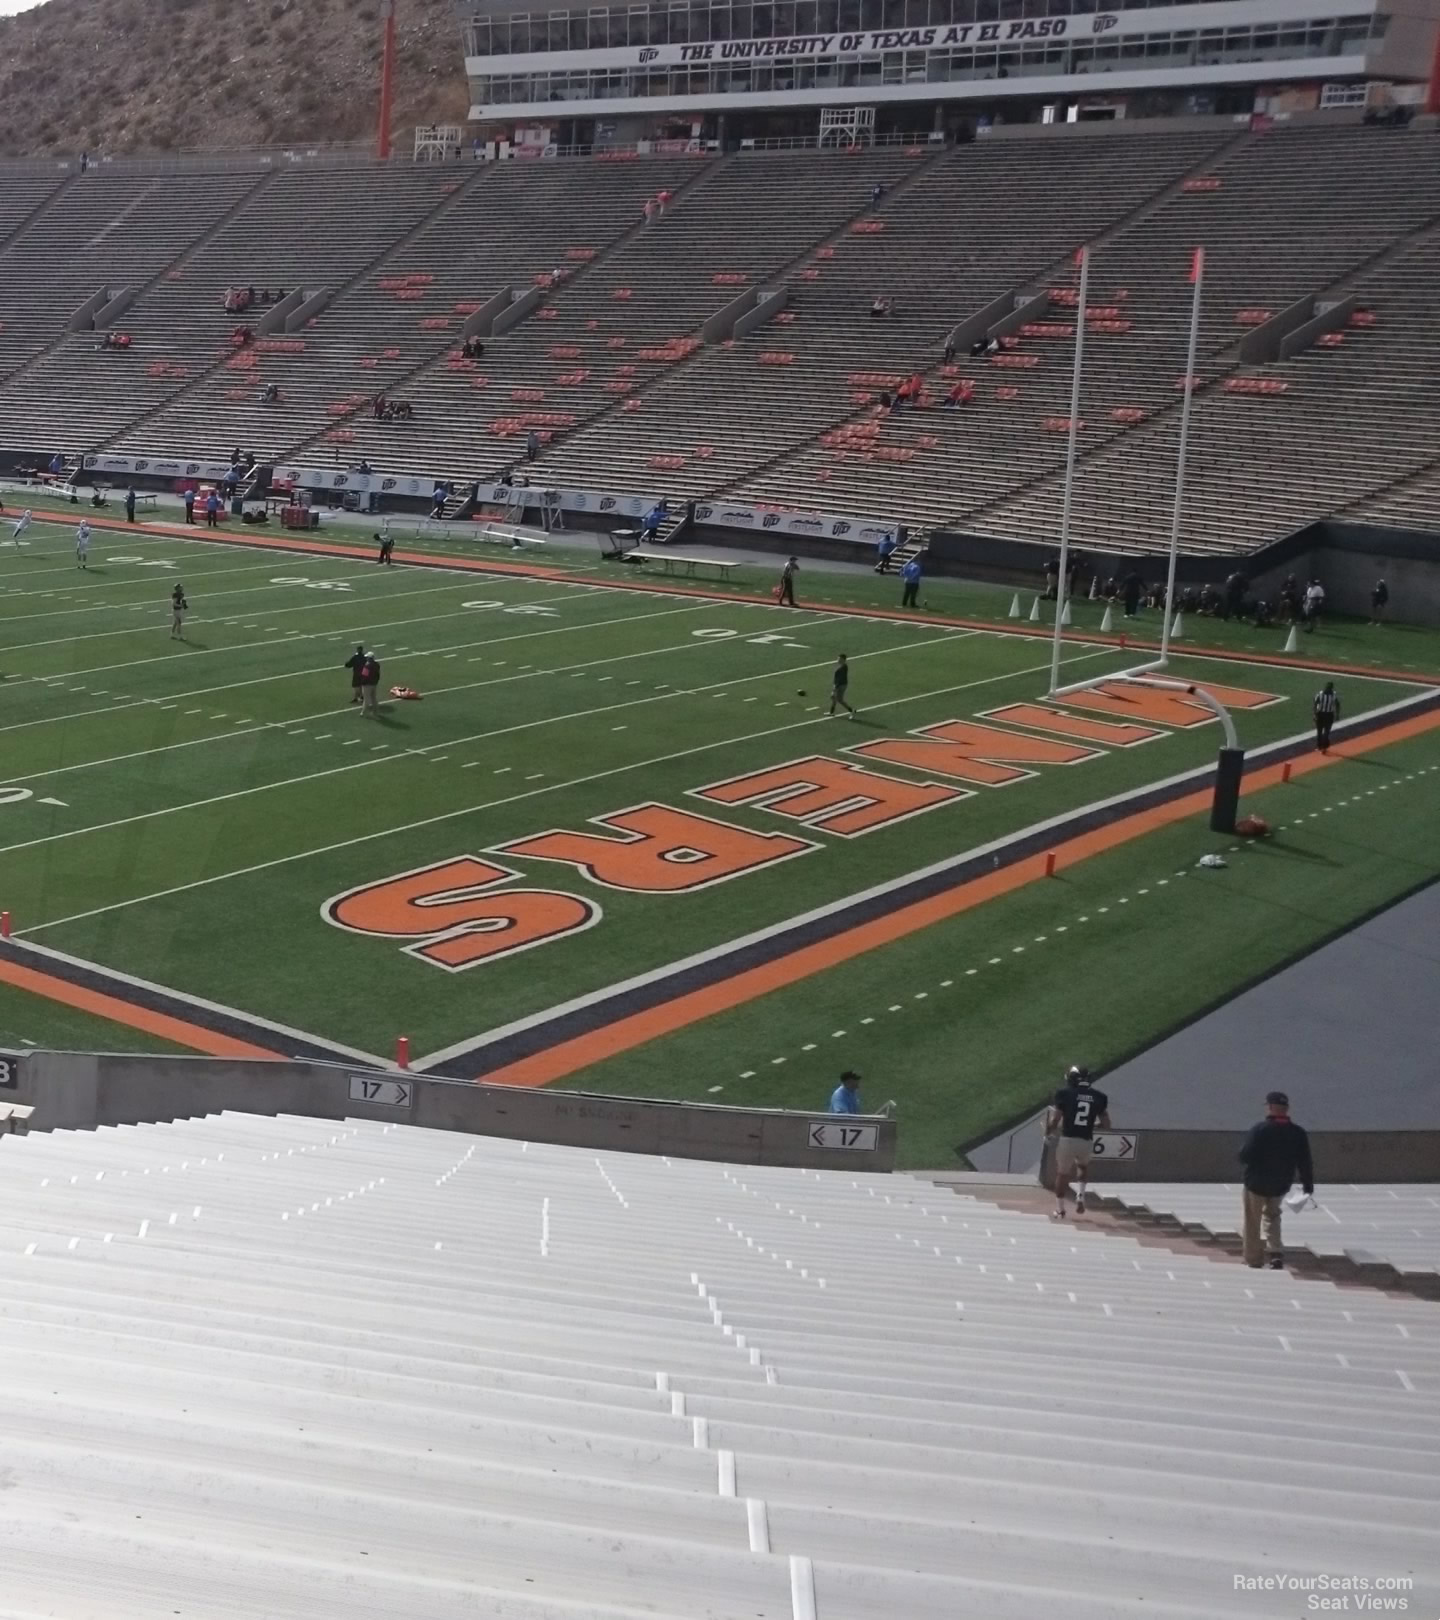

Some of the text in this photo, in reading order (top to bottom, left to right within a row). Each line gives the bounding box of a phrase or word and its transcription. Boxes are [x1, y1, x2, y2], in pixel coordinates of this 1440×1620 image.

[680, 19, 1067, 61] THE UNIVERSITY OF TEXAS AT EL PASO
[319, 671, 1290, 973] MINERS
[361, 1081, 382, 1099] 17
[1074, 1101, 1091, 1126] 2
[839, 1128, 862, 1147] 17
[1093, 1137, 1105, 1155] 6
